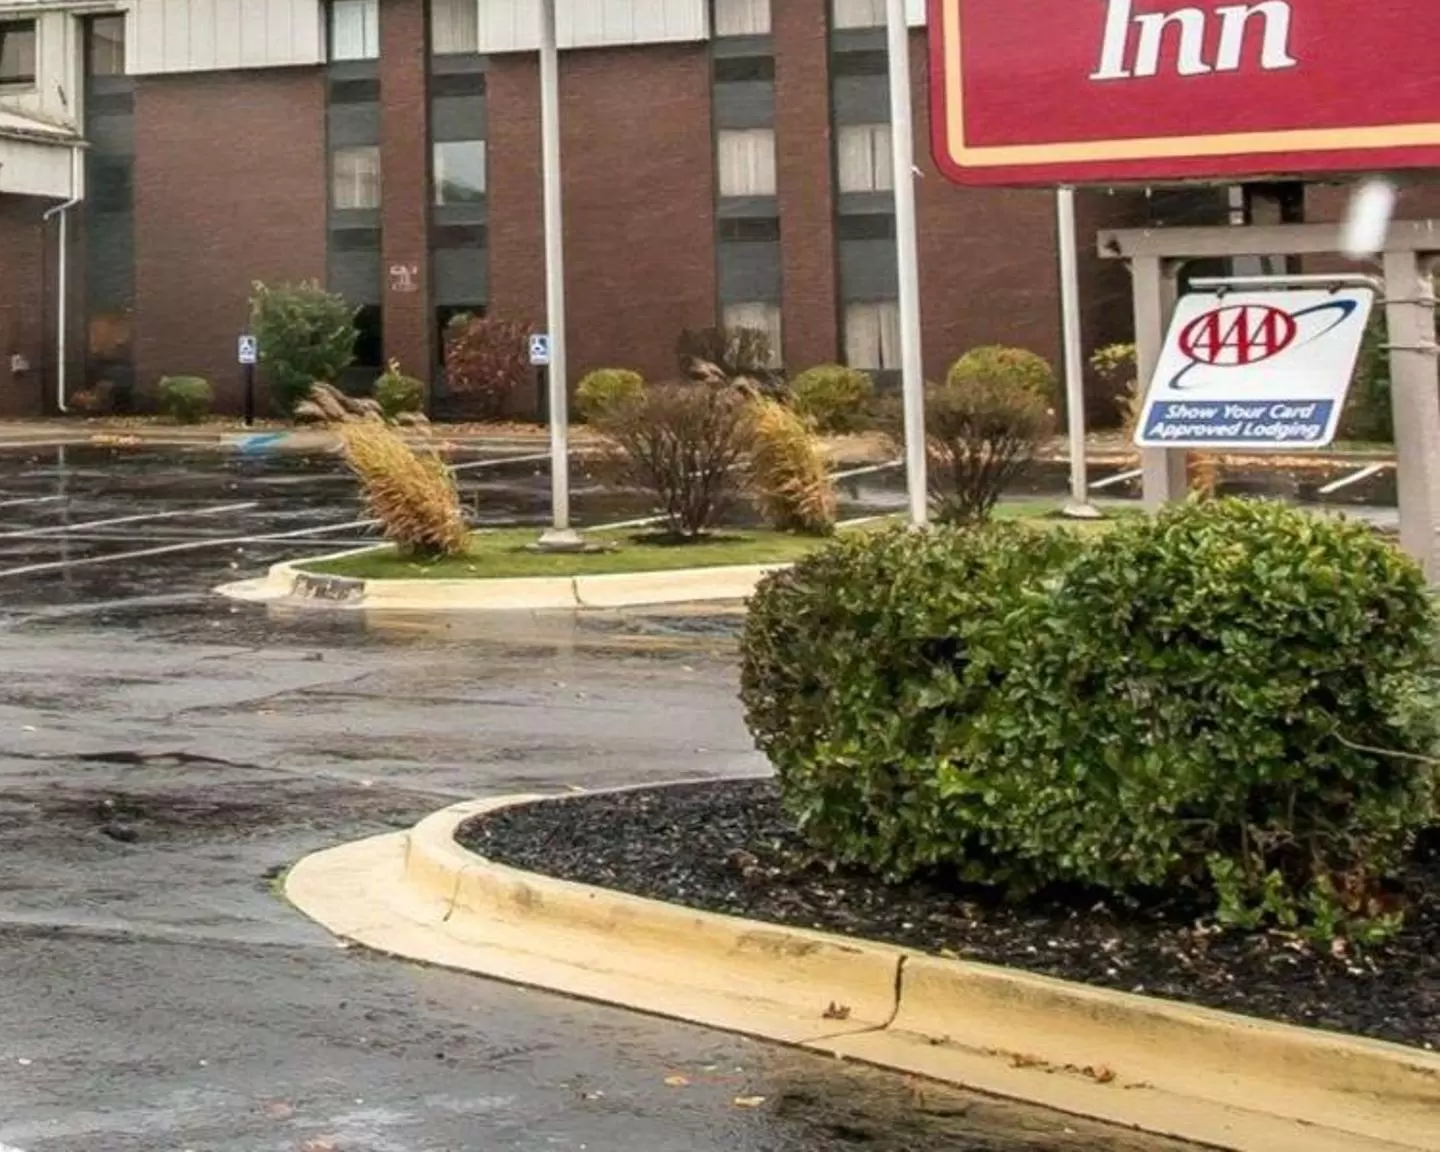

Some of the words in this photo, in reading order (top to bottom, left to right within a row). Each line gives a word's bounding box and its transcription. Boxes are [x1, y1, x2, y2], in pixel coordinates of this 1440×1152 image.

[1190, 304, 1289, 366] AAA
[1164, 404, 1218, 420] Show
[1224, 404, 1266, 420] Your
[1269, 404, 1315, 419] Card
[1150, 422, 1241, 438] Approved
[1242, 422, 1321, 440] Lodging
